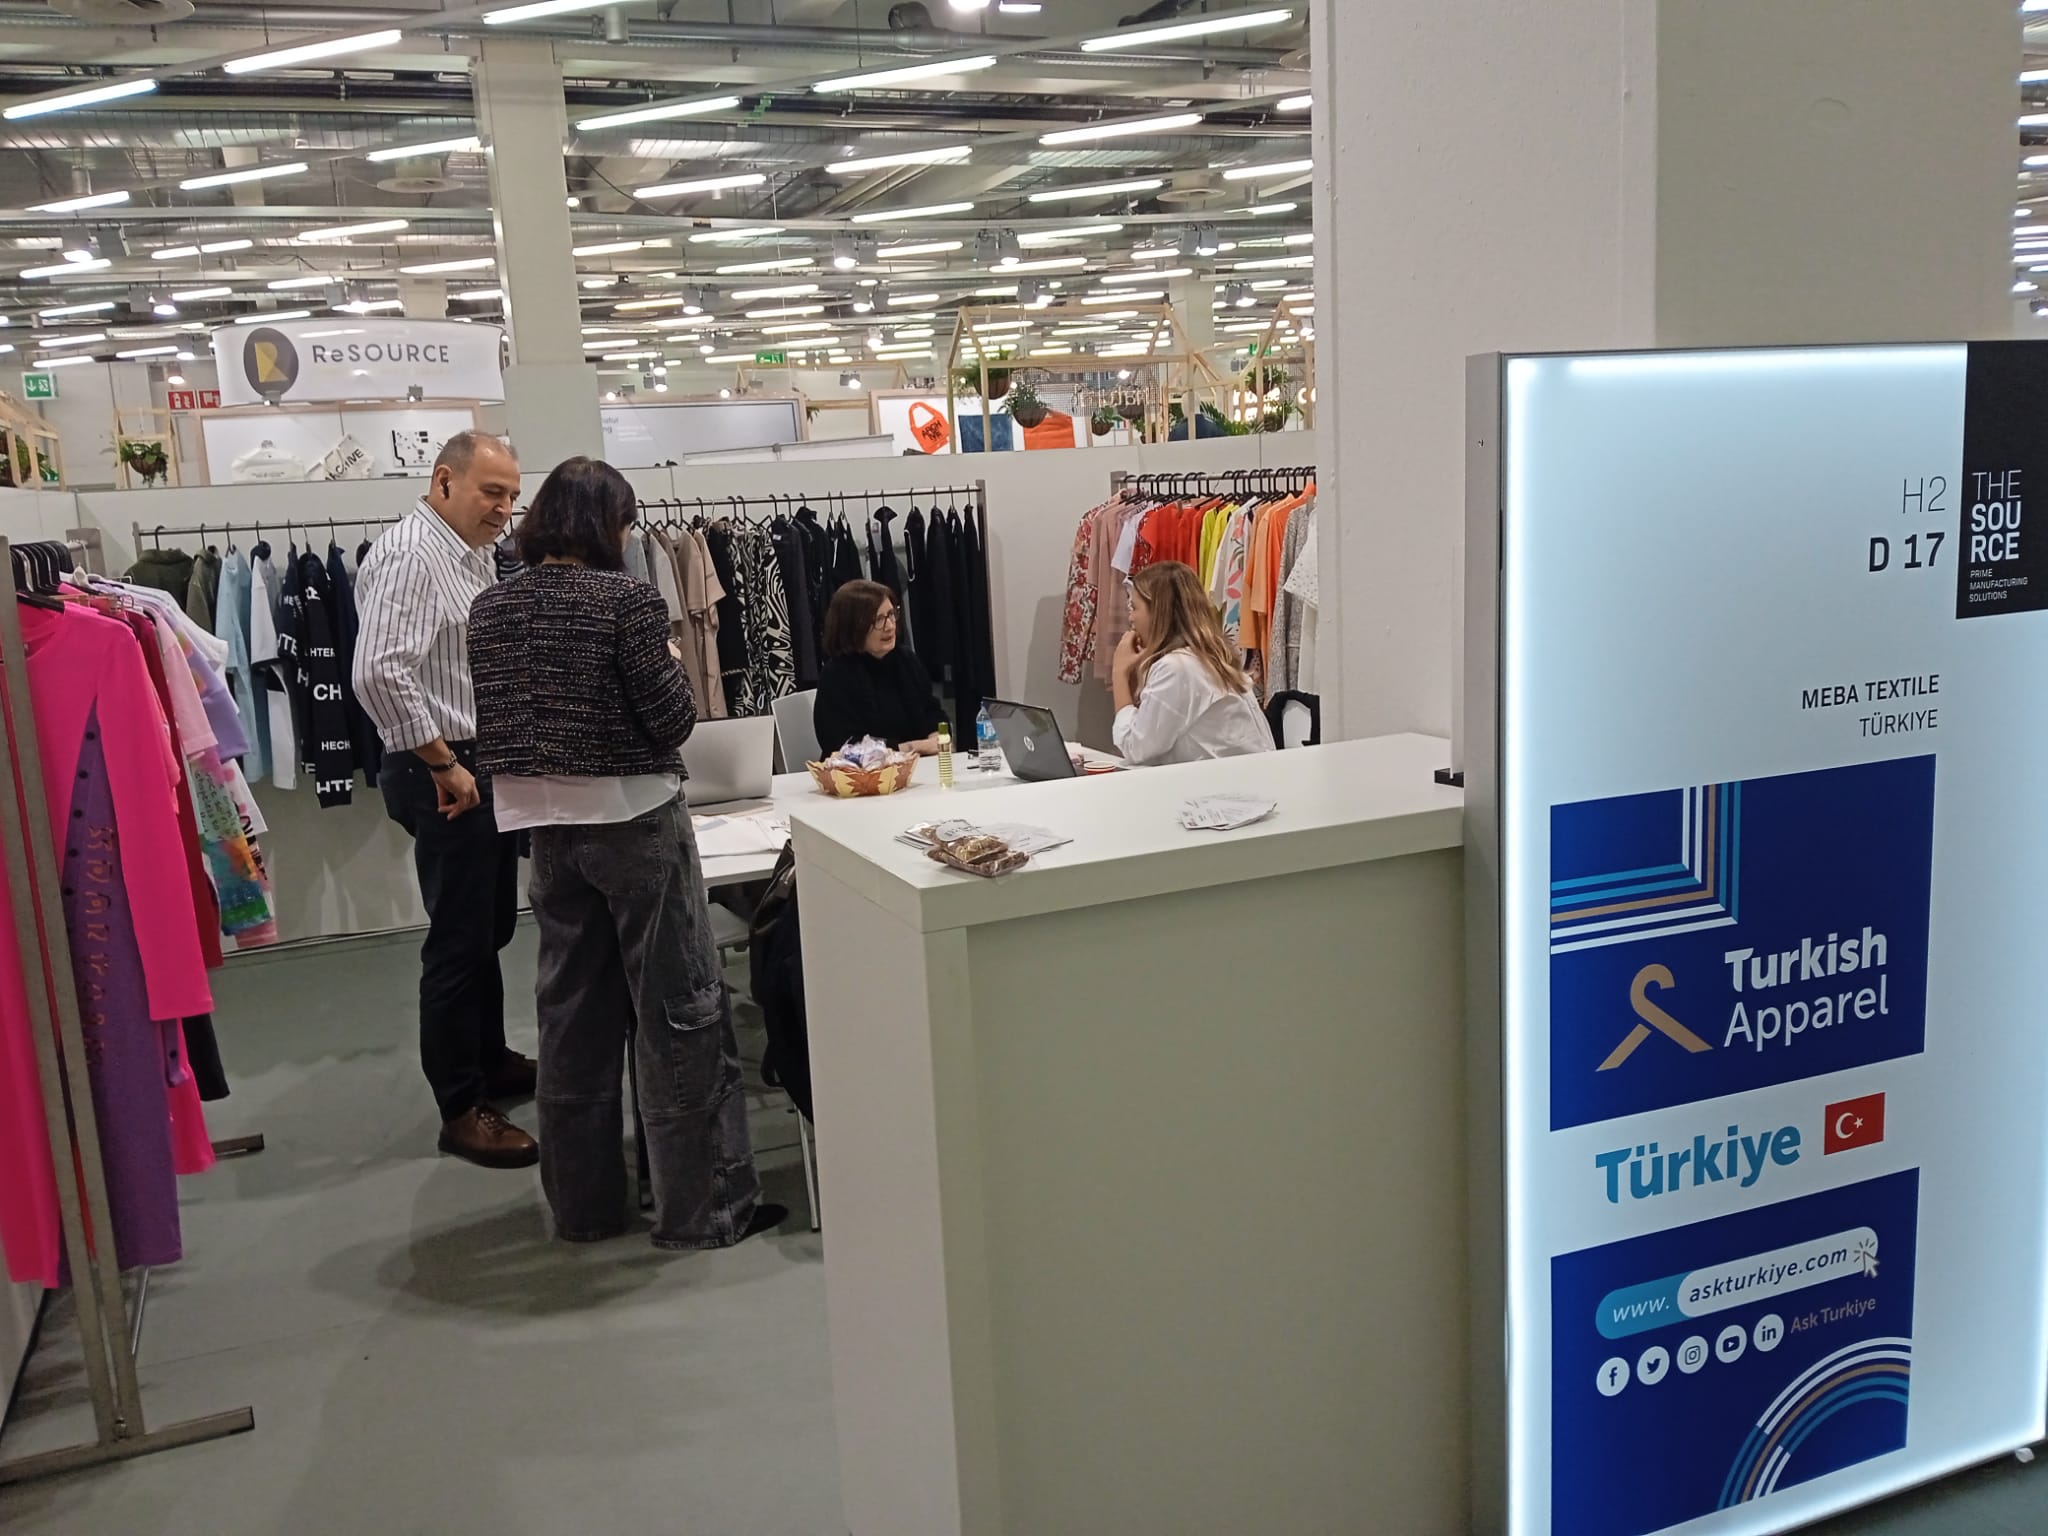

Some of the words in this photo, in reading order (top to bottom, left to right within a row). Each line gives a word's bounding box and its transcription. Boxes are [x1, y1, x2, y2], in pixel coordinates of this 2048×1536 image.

[312, 343, 449, 364] ReSOURCE
[1902, 475, 1947, 514] H2
[1971, 470, 2022, 501] THE
[1971, 501, 2022, 533] SOU
[1868, 536, 1890, 573] D
[1904, 532, 1945, 569] 17
[1970, 531, 2020, 563] RCE
[1969, 576, 2028, 591] MANUFACTURING
[1970, 568, 1993, 579] PRIME
[1969, 590, 2008, 602] SOLUTIONS
[1801, 683, 1859, 710] MEBA
[1865, 674, 1940, 702] TEXTILE
[1859, 708, 1939, 738] TÜRKIYE
[1724, 926, 1888, 993] Turkish
[1723, 975, 1889, 1052] Apparel
[1595, 1124, 1802, 1204] Türkiye
[1612, 1294, 1672, 1324] www.
[1688, 1245, 1848, 1304] askturkiye.com
[1790, 1313, 1818, 1334] Ask
[1821, 1296, 1877, 1325] Turkiye
